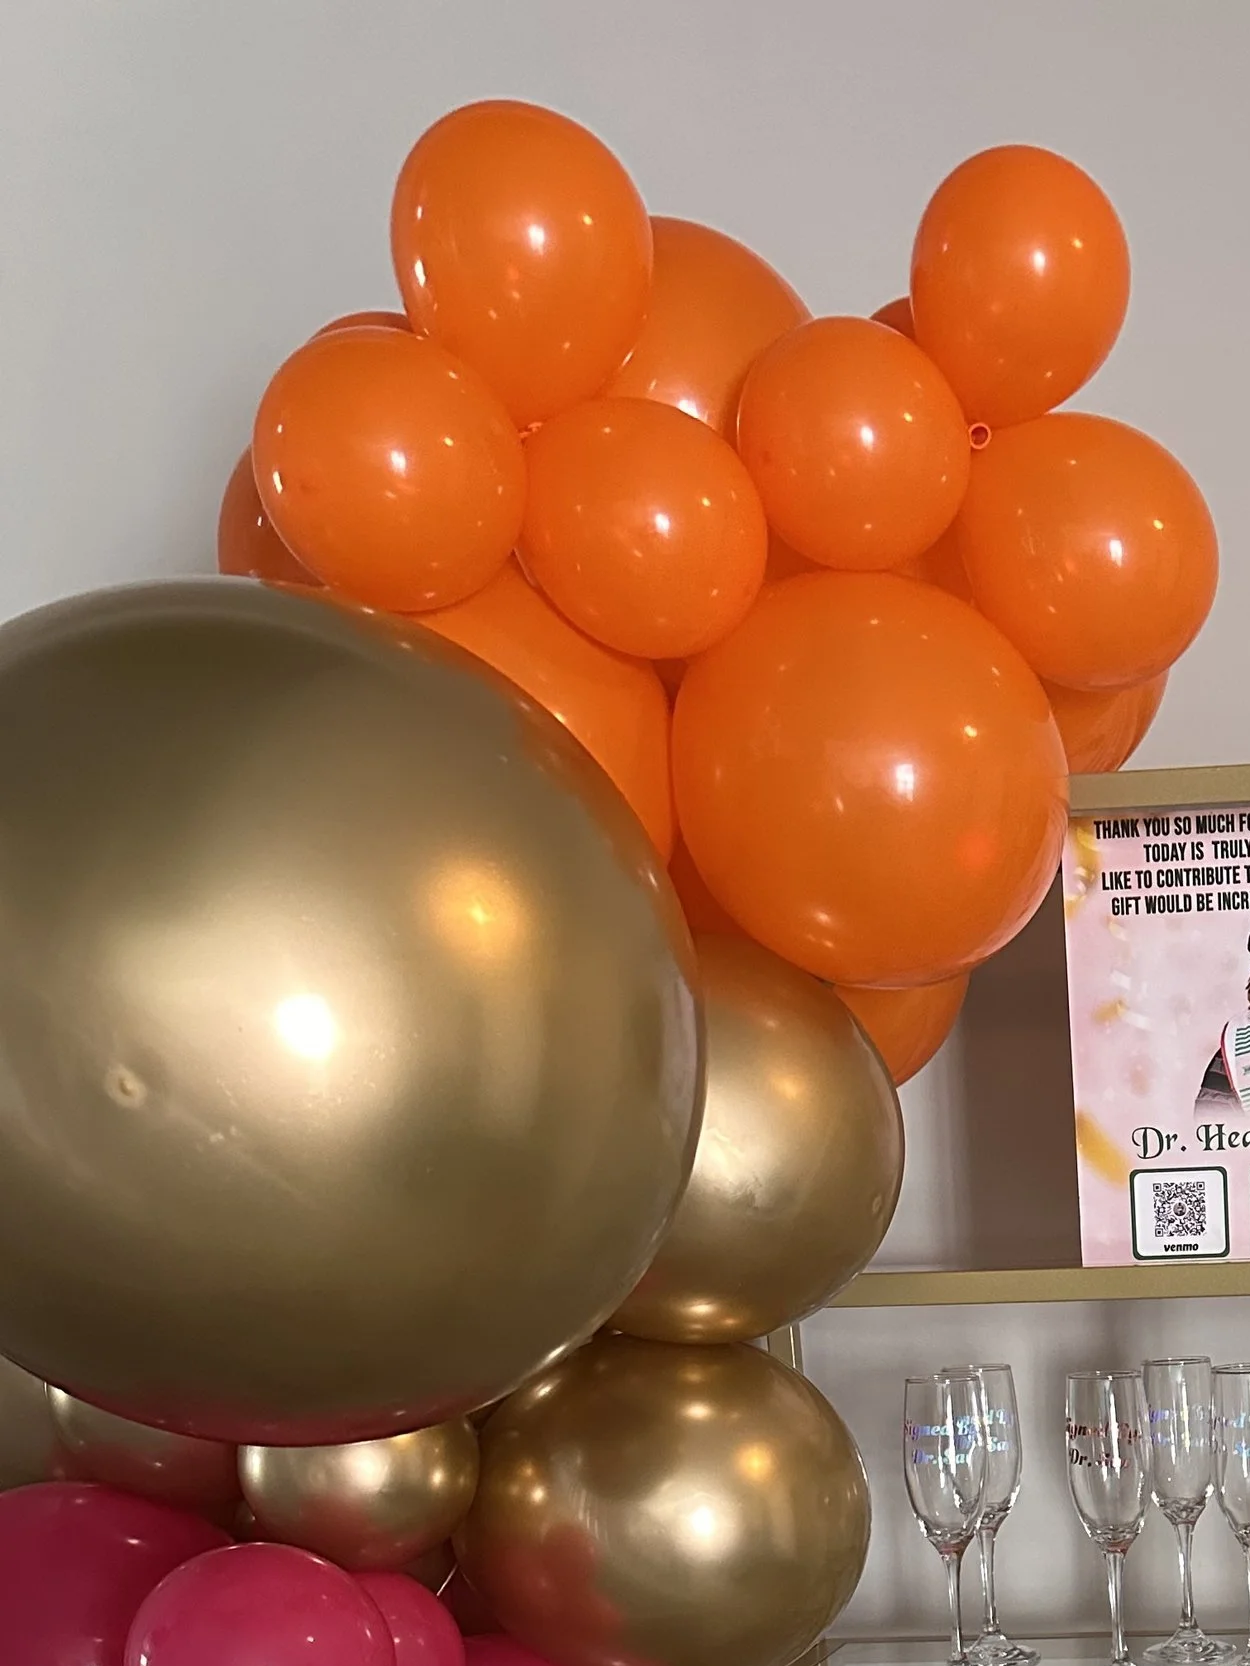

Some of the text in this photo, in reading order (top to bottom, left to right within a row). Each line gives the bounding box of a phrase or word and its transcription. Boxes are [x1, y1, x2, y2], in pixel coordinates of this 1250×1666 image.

[1094, 820, 1140, 839] THANK
[1143, 816, 1170, 836] YOU
[1174, 815, 1192, 835] SO
[1195, 812, 1235, 834] MUCH
[1143, 842, 1187, 862] TODAY
[1191, 841, 1204, 860] IS
[1102, 871, 1131, 890] LIKE
[1135, 870, 1152, 889] TO
[1156, 866, 1241, 888] CONTRIBUTE
[1112, 897, 1141, 915] GIFT
[1145, 894, 1192, 914] WOULD
[1196, 893, 1213, 911] BE
[1132, 1126, 1187, 1159] Dr.
[1163, 1242, 1199, 1252] venmo
[1069, 1448, 1092, 1467] Dr.
